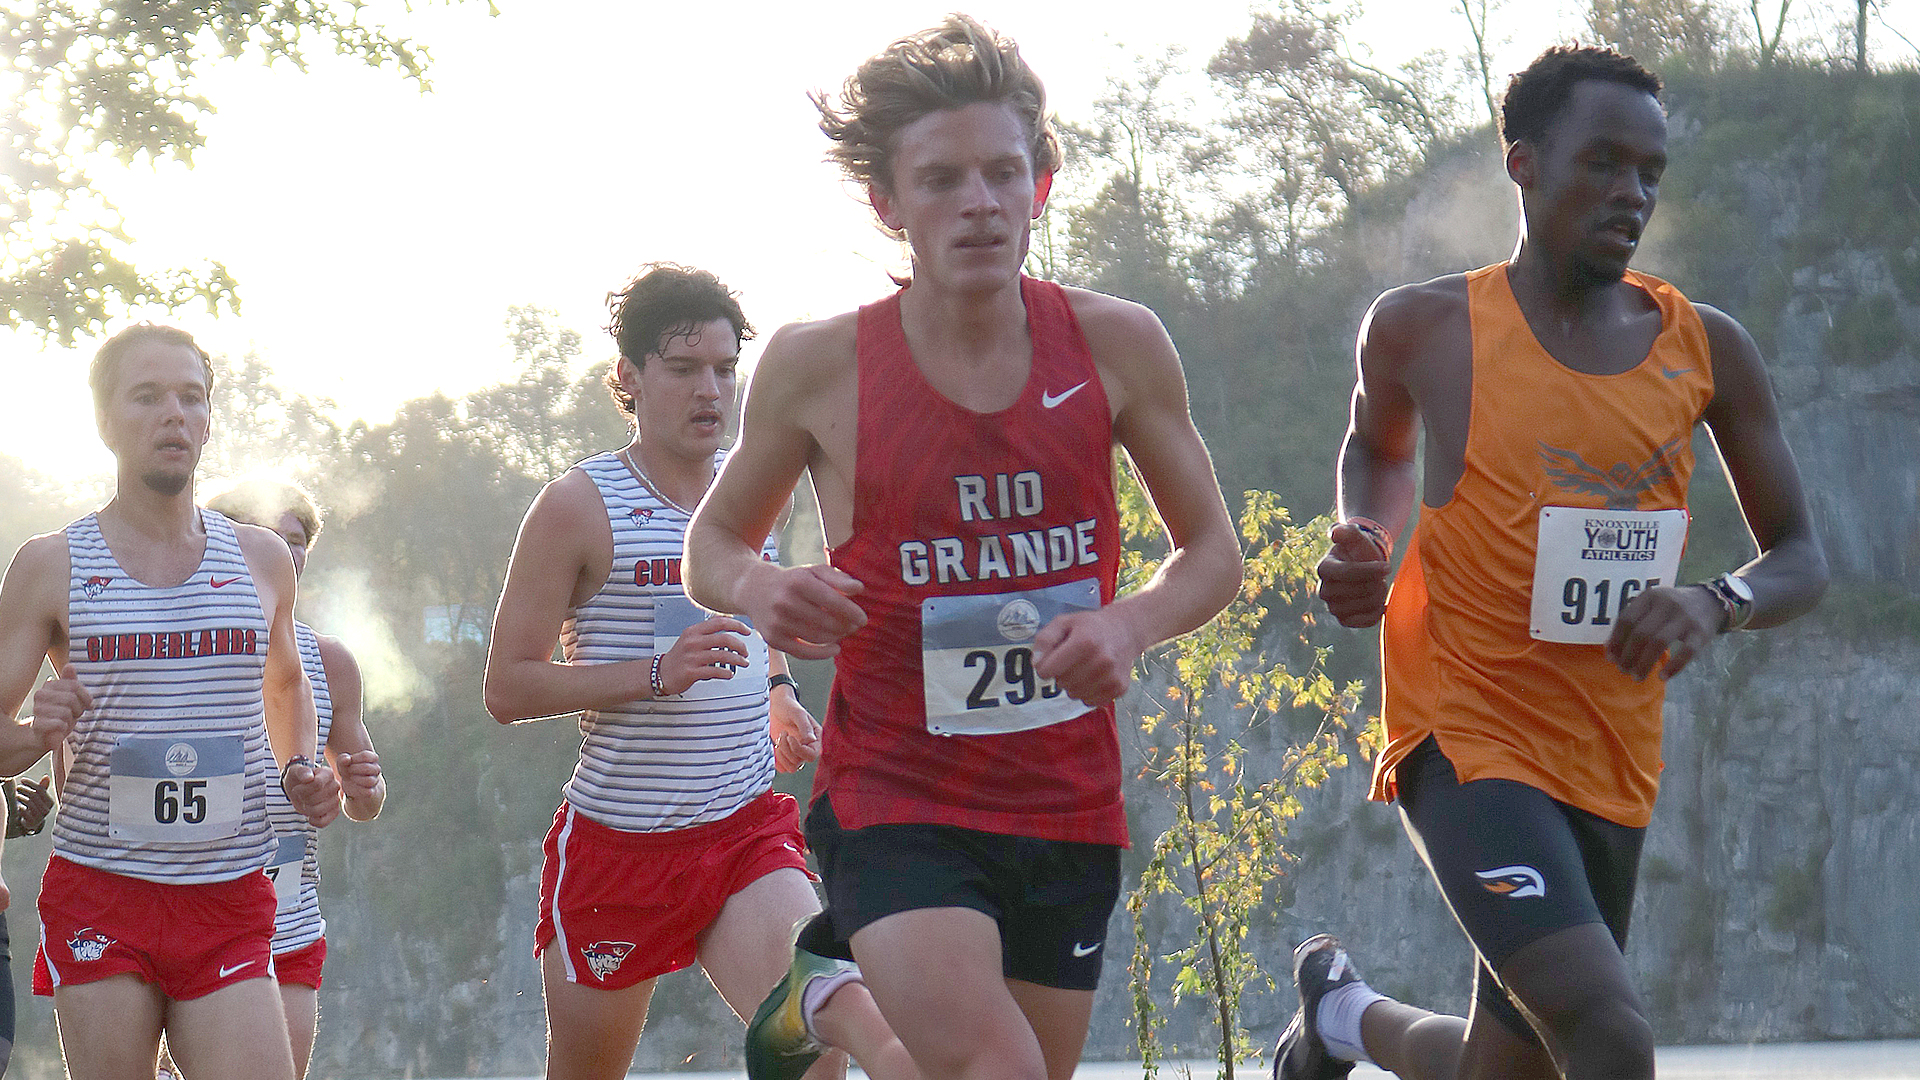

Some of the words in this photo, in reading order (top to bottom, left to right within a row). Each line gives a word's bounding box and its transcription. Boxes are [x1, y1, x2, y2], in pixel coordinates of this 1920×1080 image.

[954, 469, 1044, 521] RIO
[1584, 527, 1658, 549] YOUTH
[1585, 519, 1660, 529] KNOXVILLE
[899, 517, 1099, 586] GRANDE
[1586, 550, 1654, 560] ATHLETICS
[634, 558, 682, 587] CUM
[1561, 577, 1660, 625] 916
[86, 628, 257, 662] CUMBERLANDS
[963, 647, 1063, 710] 29
[154, 780, 207, 824] 65
